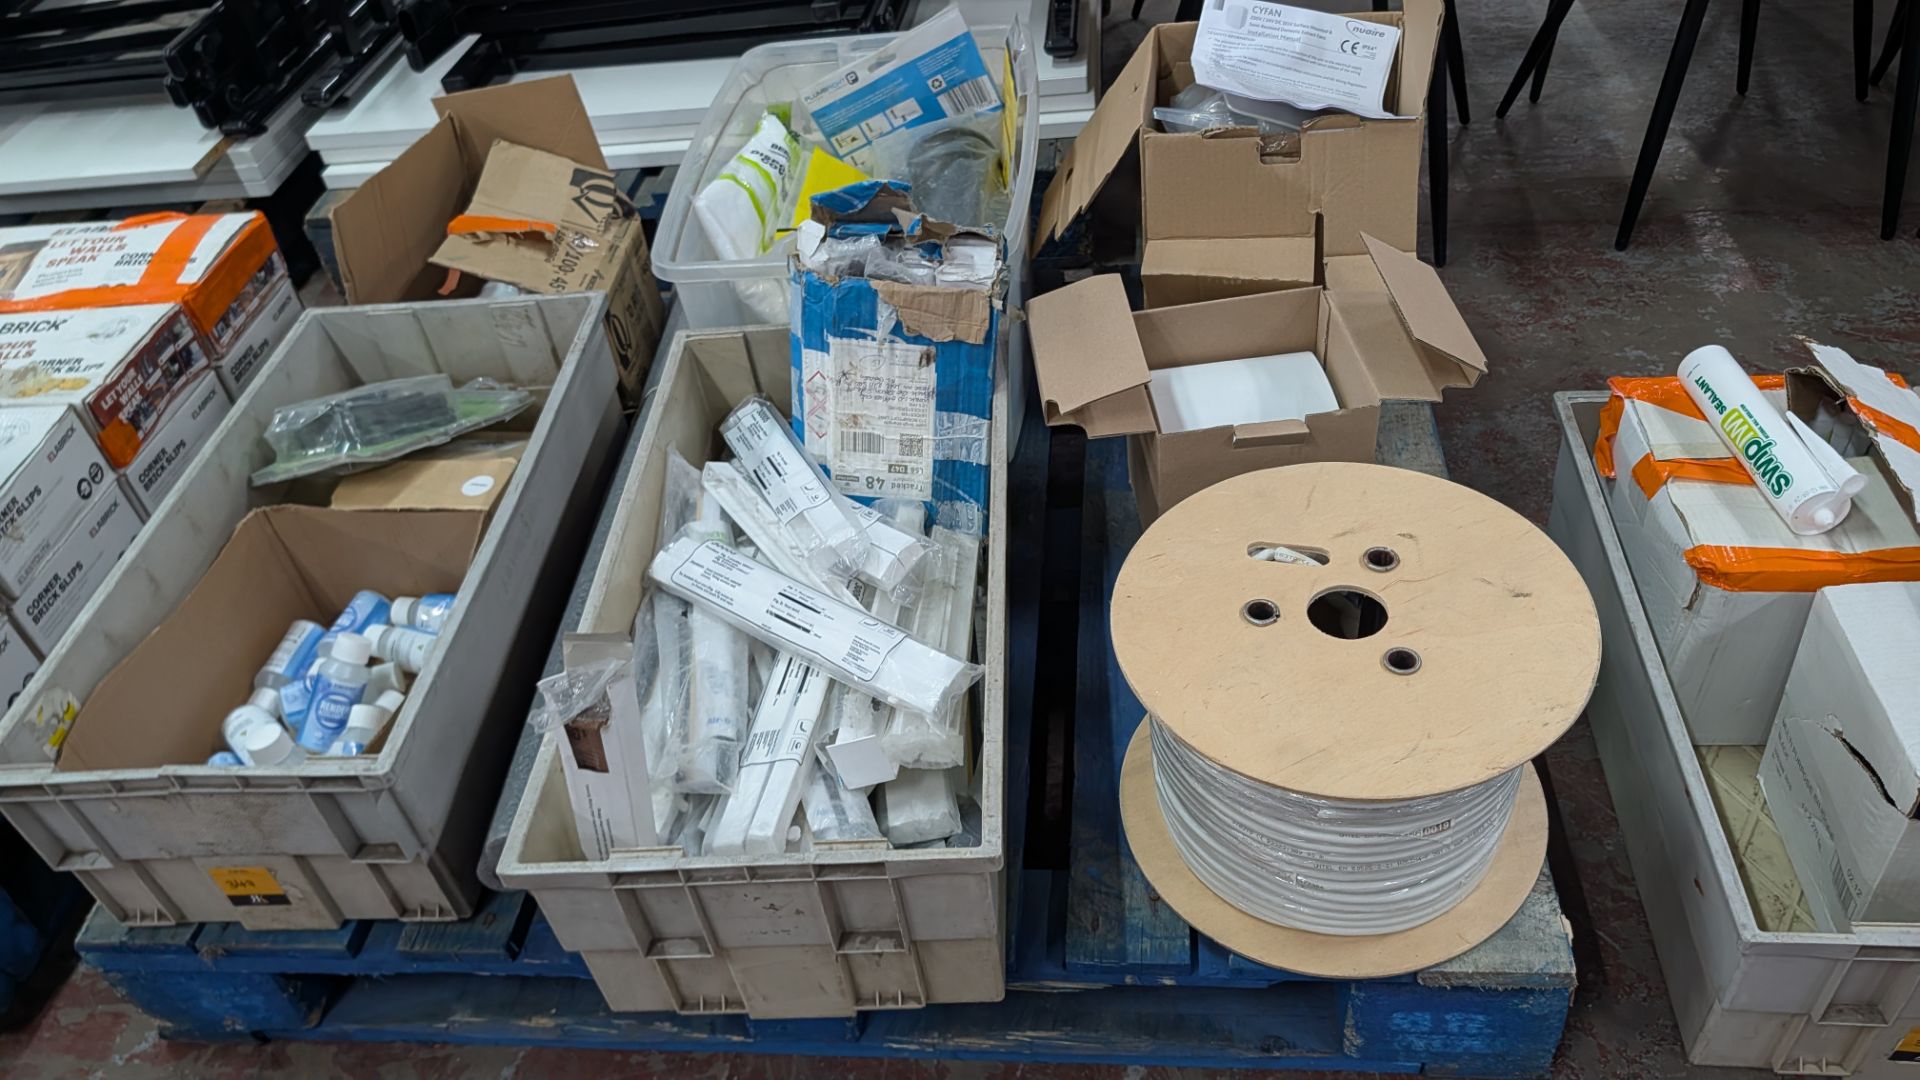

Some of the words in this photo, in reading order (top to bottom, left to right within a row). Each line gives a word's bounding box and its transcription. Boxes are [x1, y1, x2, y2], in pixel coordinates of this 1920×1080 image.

[1252, 5, 1282, 17] CYFAN
[1247, 30, 1280, 39] Installation
[1280, 34, 1301, 42] Manual
[1352, 26, 1386, 38] nuaire
[79, 235, 127, 246] YOUR
[70, 243, 127, 255] WALLS
[46, 254, 99, 268] SPEAK
[1695, 376, 1727, 415] SEALANT
[138, 447, 168, 484] CORNER
[143, 466, 167, 492] BRICK
[164, 439, 187, 468] SLIPS
[865, 475, 886, 490] 48
[891, 482, 924, 492] Tracked
[16, 485, 42, 516] SLIPS
[26, 573, 62, 616] CORNER
[32, 589, 60, 626] BRICK
[58, 561, 84, 593] SLIPS
